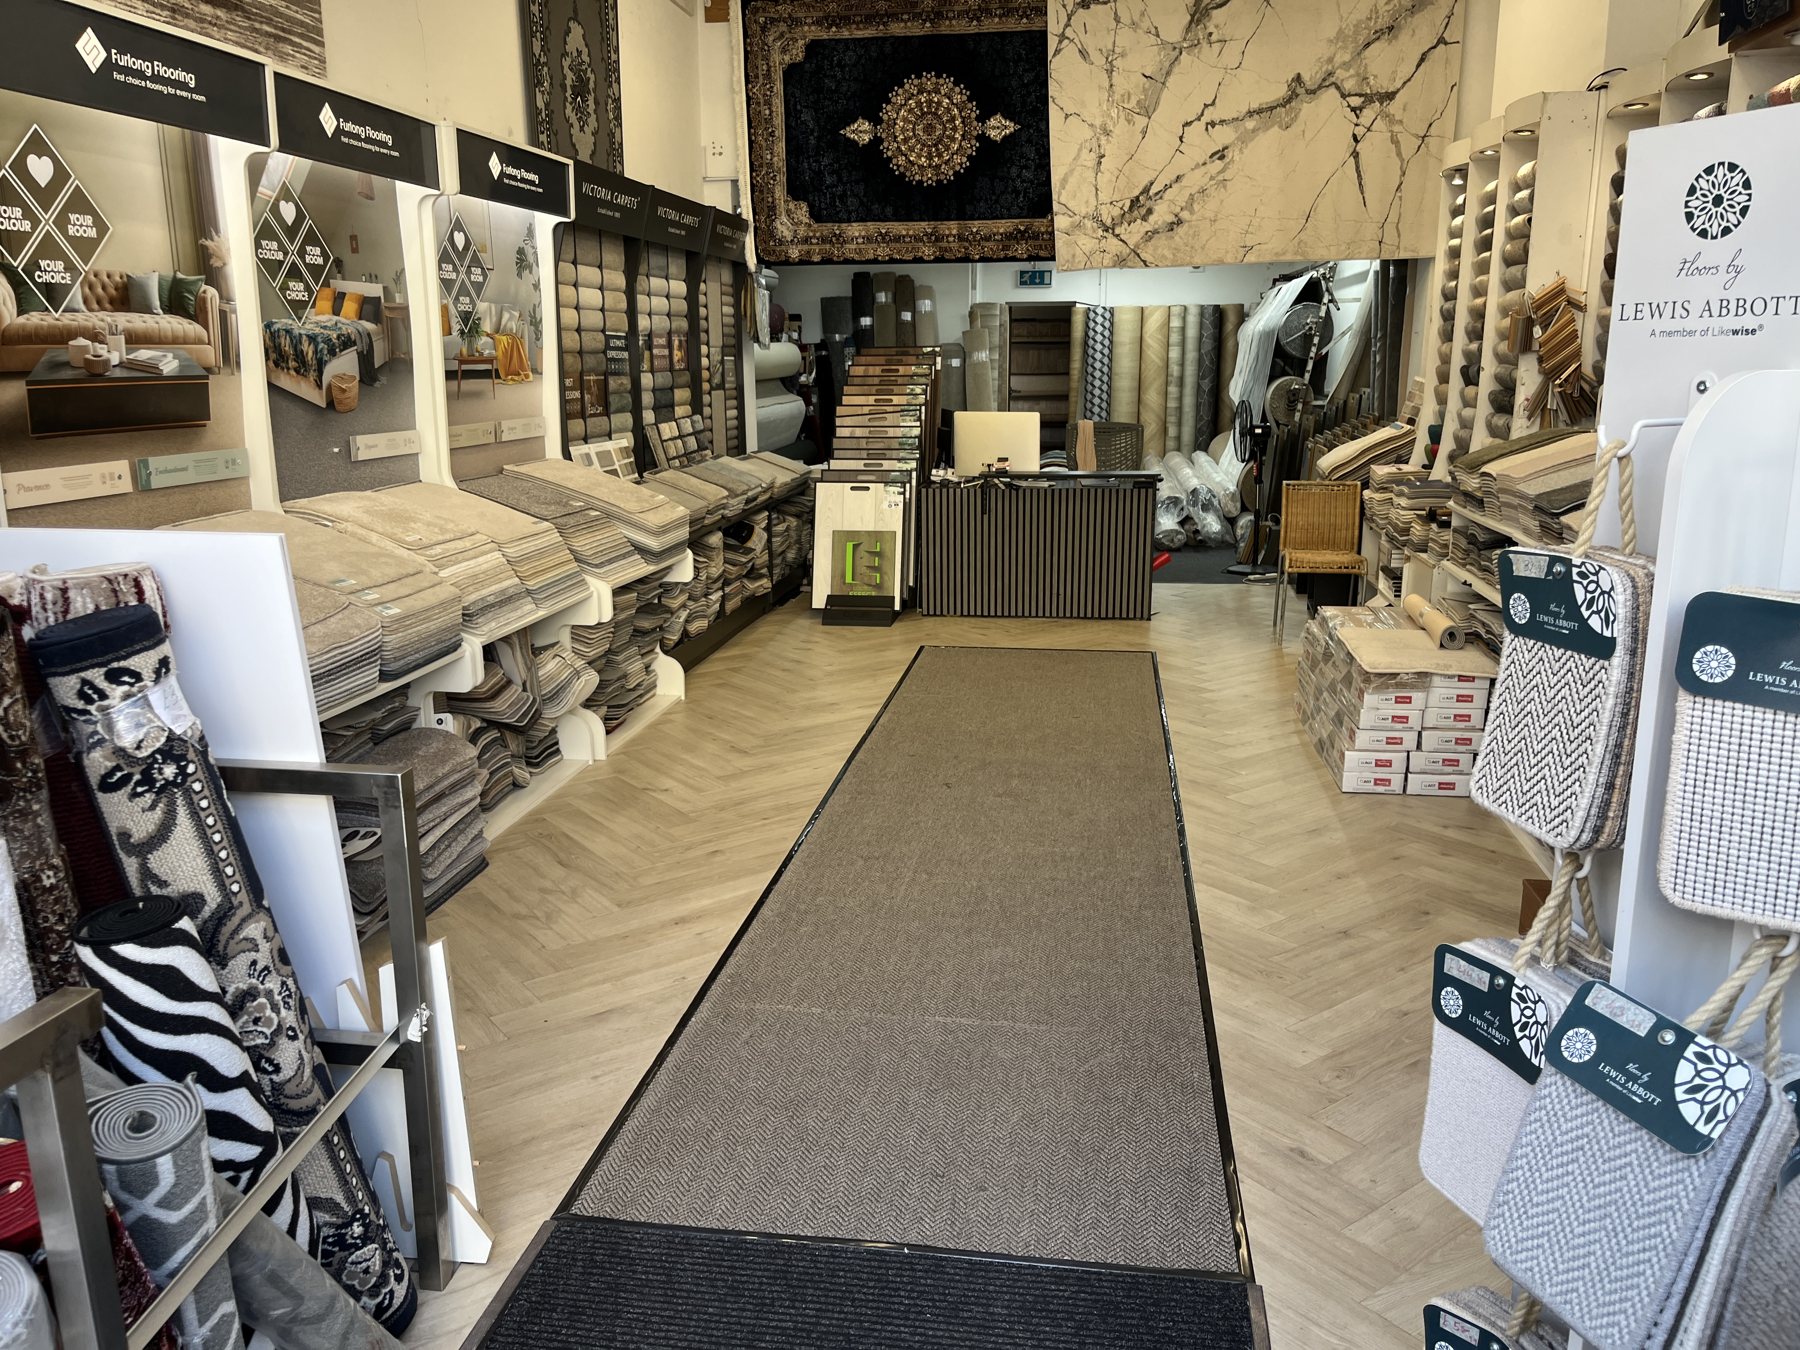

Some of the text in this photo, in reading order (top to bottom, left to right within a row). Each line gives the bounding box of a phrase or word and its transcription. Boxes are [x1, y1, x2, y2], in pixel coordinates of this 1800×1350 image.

[111, 49, 195, 88] Furlong Flooring
[113, 71, 125, 82] First
[126, 75, 145, 87] choice
[146, 80, 168, 94] flooring
[176, 89, 191, 99] every
[192, 93, 207, 102] room
[339, 118, 393, 146] Furlong Flooring
[502, 163, 539, 185] Furlong Flooring
[581, 181, 612, 202] VICTORIA
[68, 213, 94, 226] YOUR
[657, 205, 680, 222] VICTORIA
[0, 217, 32, 232] OLOUR
[67, 224, 98, 238] ROOM
[260, 239, 279, 251] YOUR
[305, 245, 321, 256] YOUR
[257, 248, 285, 261] COLOUR
[305, 254, 324, 265] ROOM
[38, 259, 65, 272] YOUR
[1676, 248, 1746, 291] Floors by
[34, 271, 72, 284] CHOICE
[288, 281, 305, 291] YOUR
[286, 290, 309, 301] CHOICE
[1618, 295, 1800, 322] LEWIS ABBOTT
[1650, 328, 1657, 338] A
[1659, 326, 1698, 338] member
[1700, 325, 1710, 337] of
[609, 338, 626, 348] ULTIMATE
[1536, 613, 1555, 626] LEWIS
[1554, 619, 1579, 631] ABBOTT
[1749, 671, 1787, 686] LEWIS
[1468, 1013, 1488, 1030] LEWIS
[1487, 1026, 1511, 1046] ABBOTT
[1598, 1062, 1662, 1106] LEWIS ABBOTT
